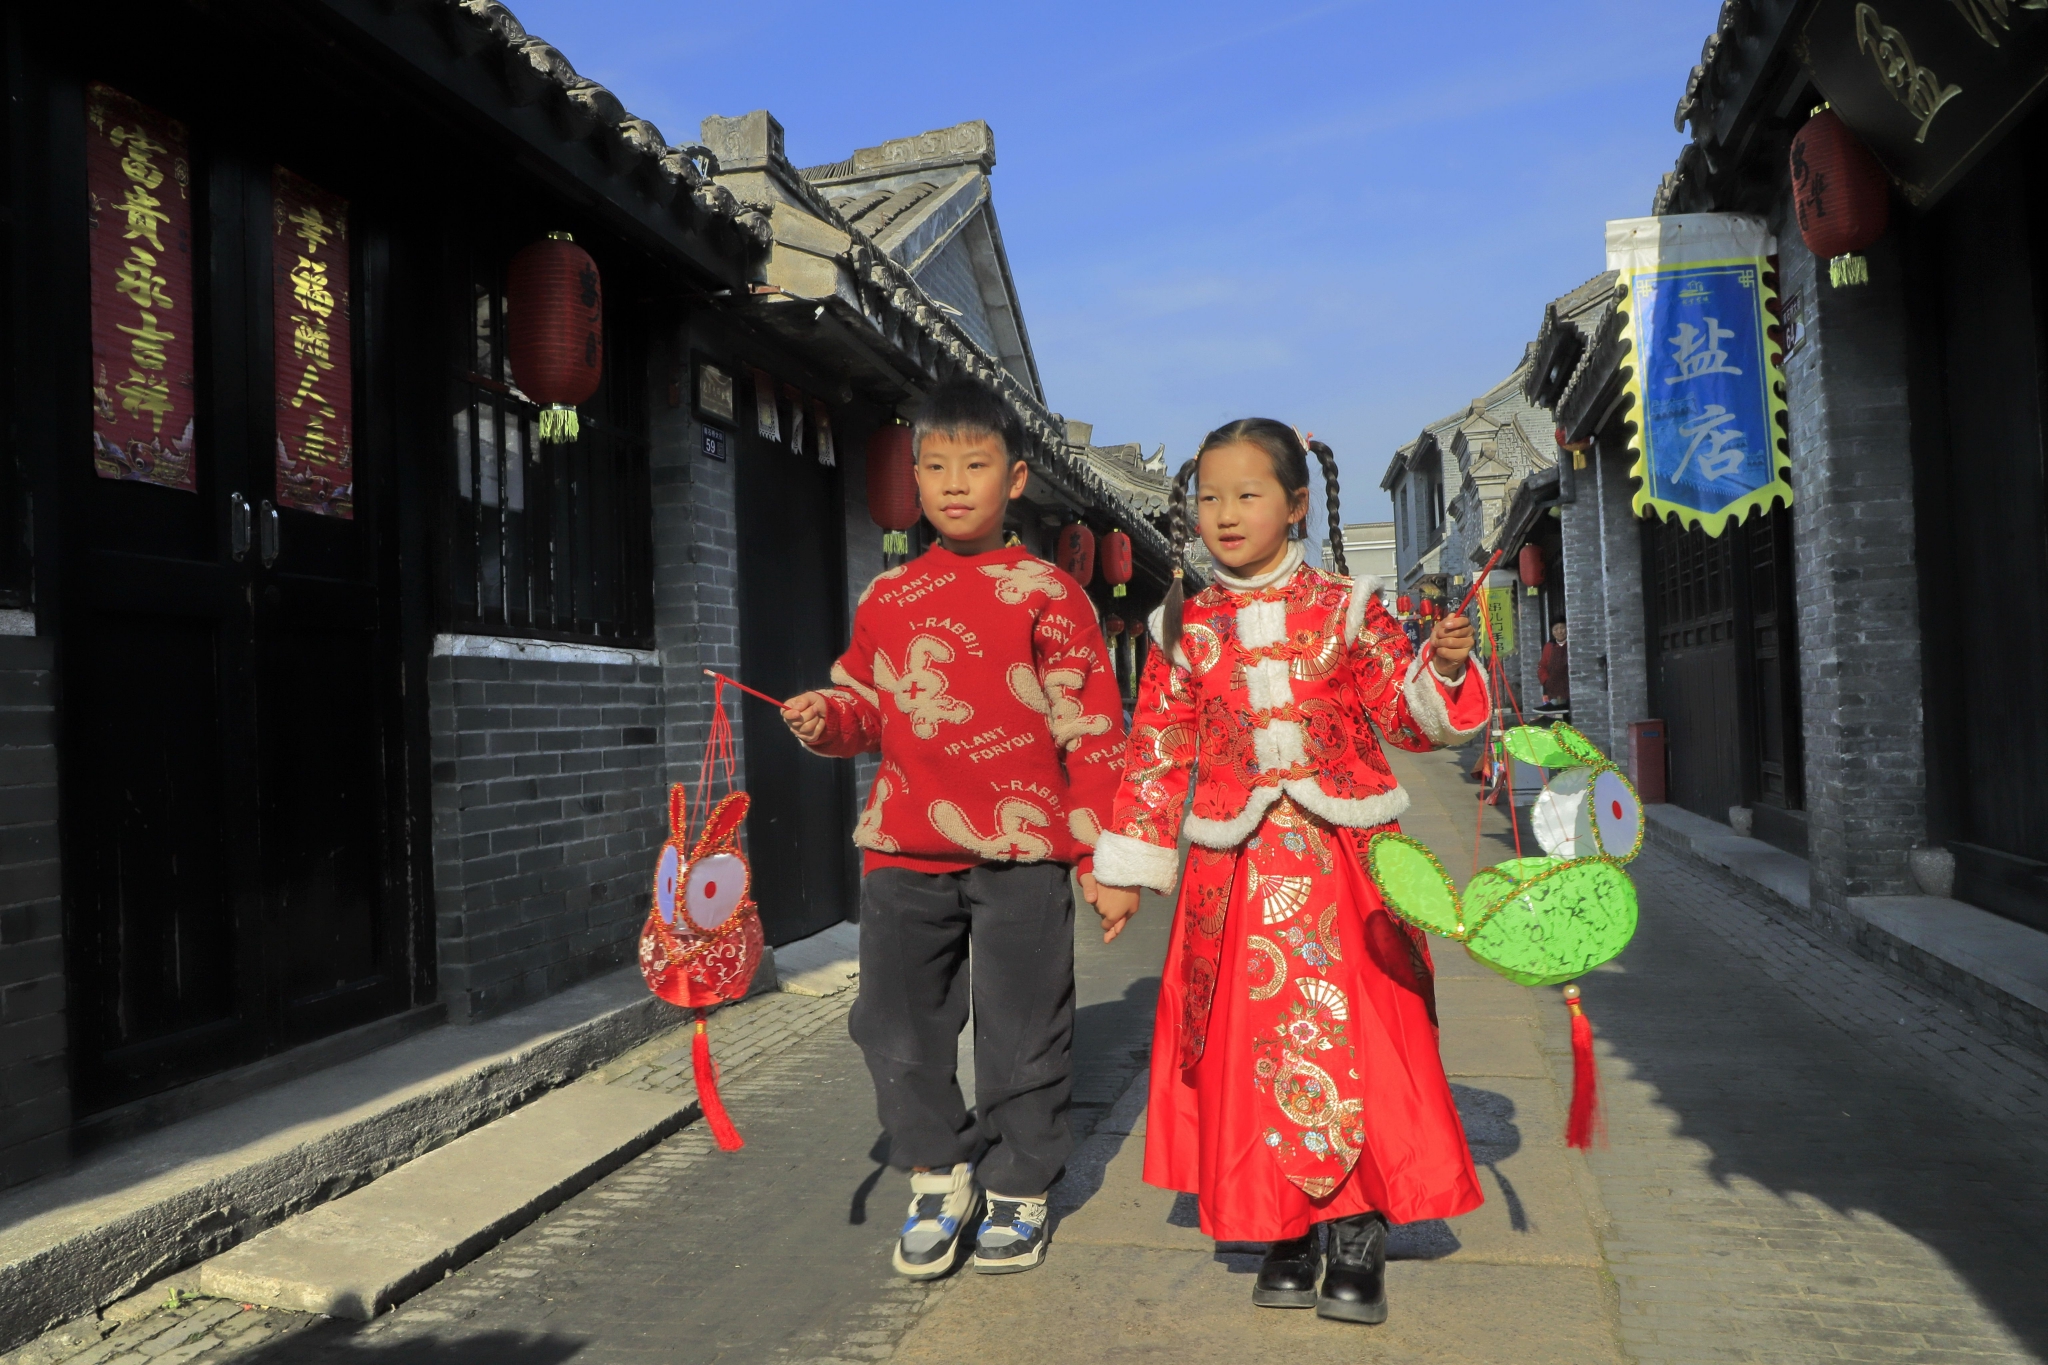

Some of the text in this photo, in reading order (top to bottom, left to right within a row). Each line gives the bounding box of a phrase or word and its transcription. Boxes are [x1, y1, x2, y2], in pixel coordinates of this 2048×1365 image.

[1664, 317, 1744, 484] 盐店
[706, 438, 716, 454] 59
[1084, 741, 1126, 764] IPLAN
